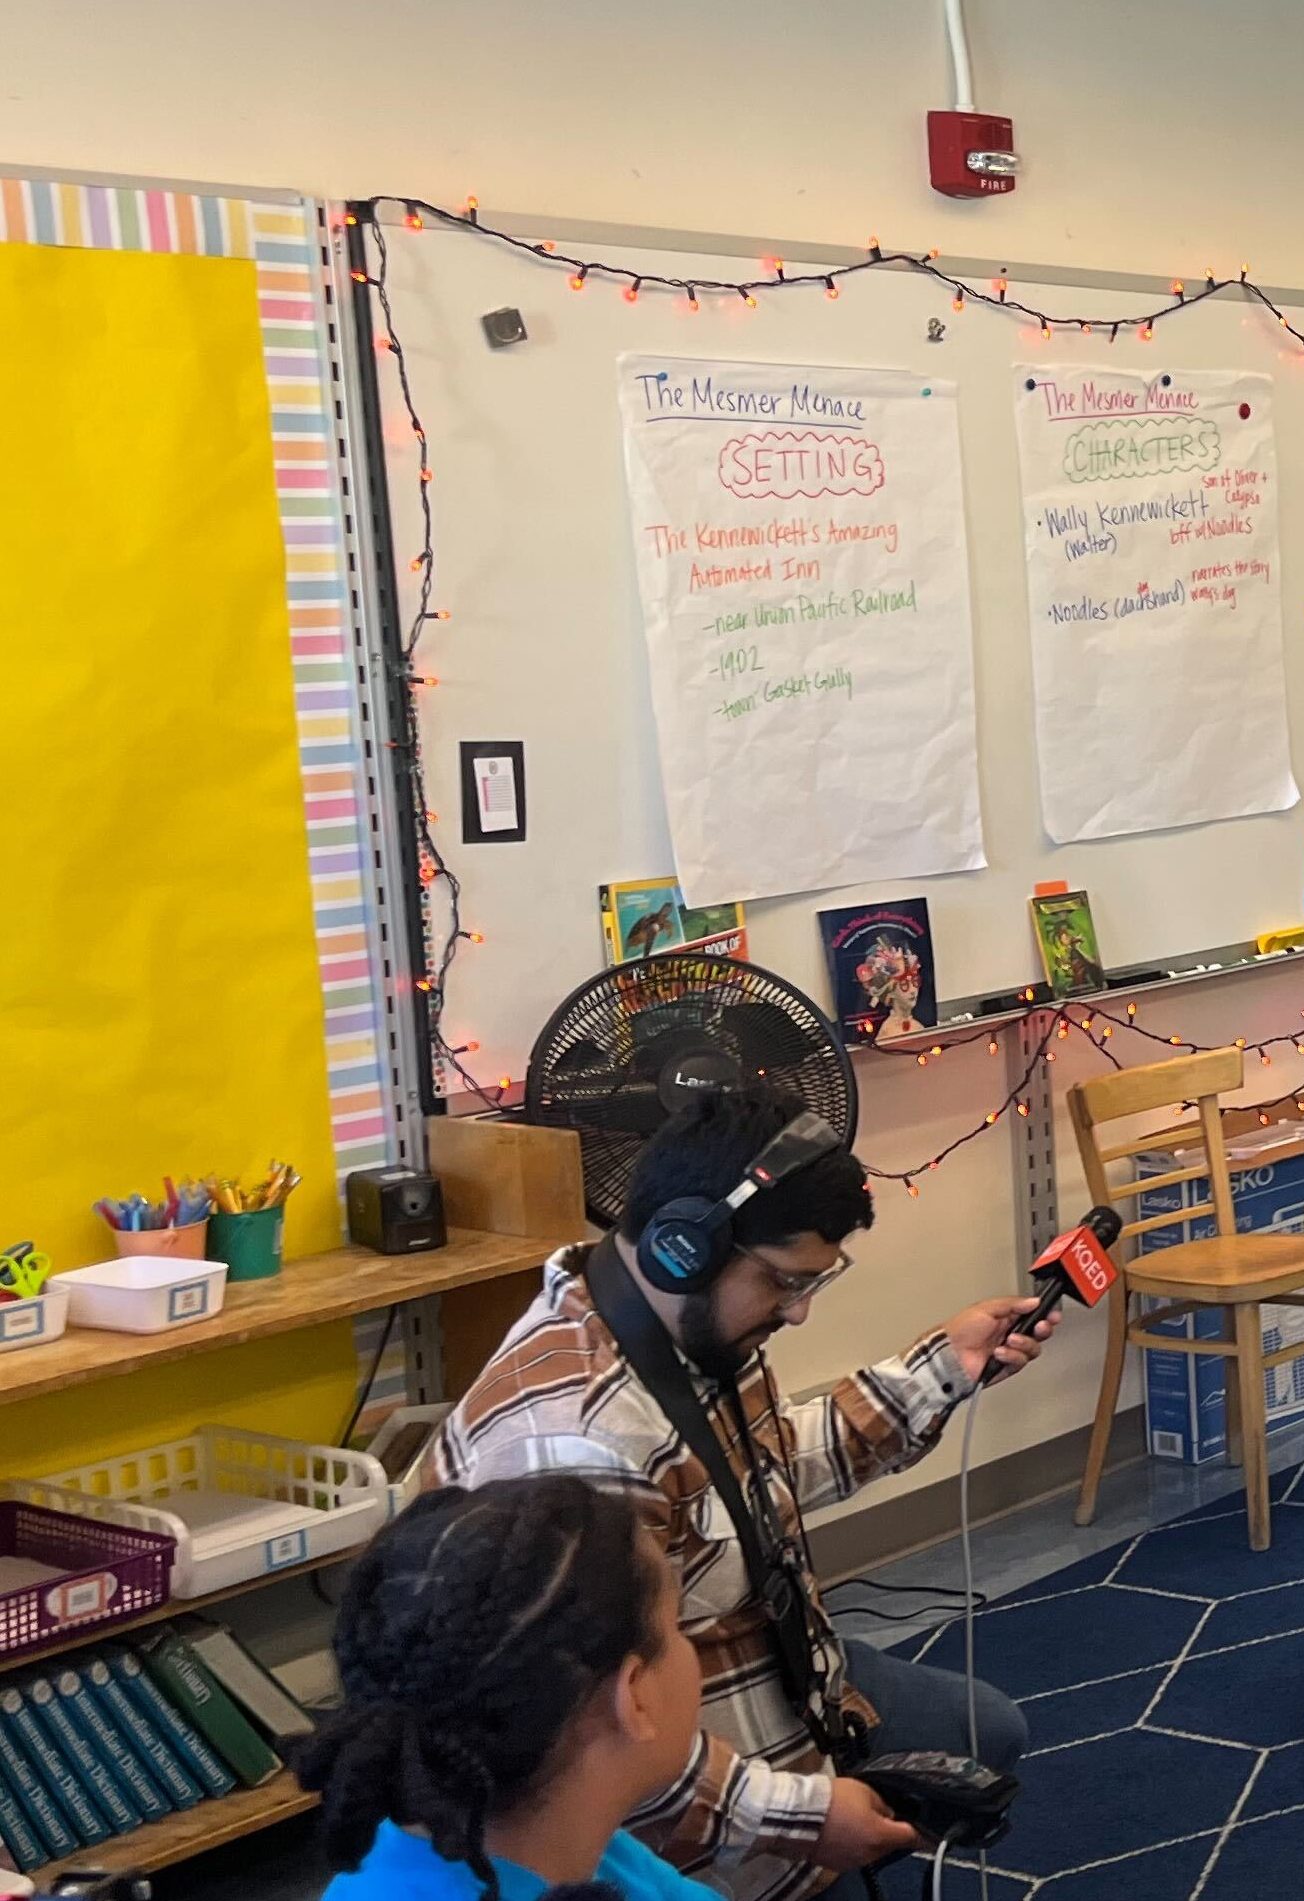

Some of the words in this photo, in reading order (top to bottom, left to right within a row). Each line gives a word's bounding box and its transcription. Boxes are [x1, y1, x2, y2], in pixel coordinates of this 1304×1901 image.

[980, 178, 1007, 191] FIRE
[635, 373, 684, 411] The
[692, 376, 783, 416] Mesmer
[790, 384, 867, 421] Menace
[1037, 382, 1075, 416] The
[1082, 381, 1139, 414] Mesmer
[1144, 383, 1200, 411] Menace
[732, 444, 873, 486] SETTING
[1072, 431, 1209, 474] CHARACTERS
[645, 524, 688, 559] The
[827, 517, 899, 554] Amazing
[1045, 504, 1089, 539] Wally
[689, 558, 773, 594] Automated
[782, 556, 821, 582] Inn
[1052, 595, 1109, 625] Noodles
[1070, 1238, 1108, 1291] KQED
